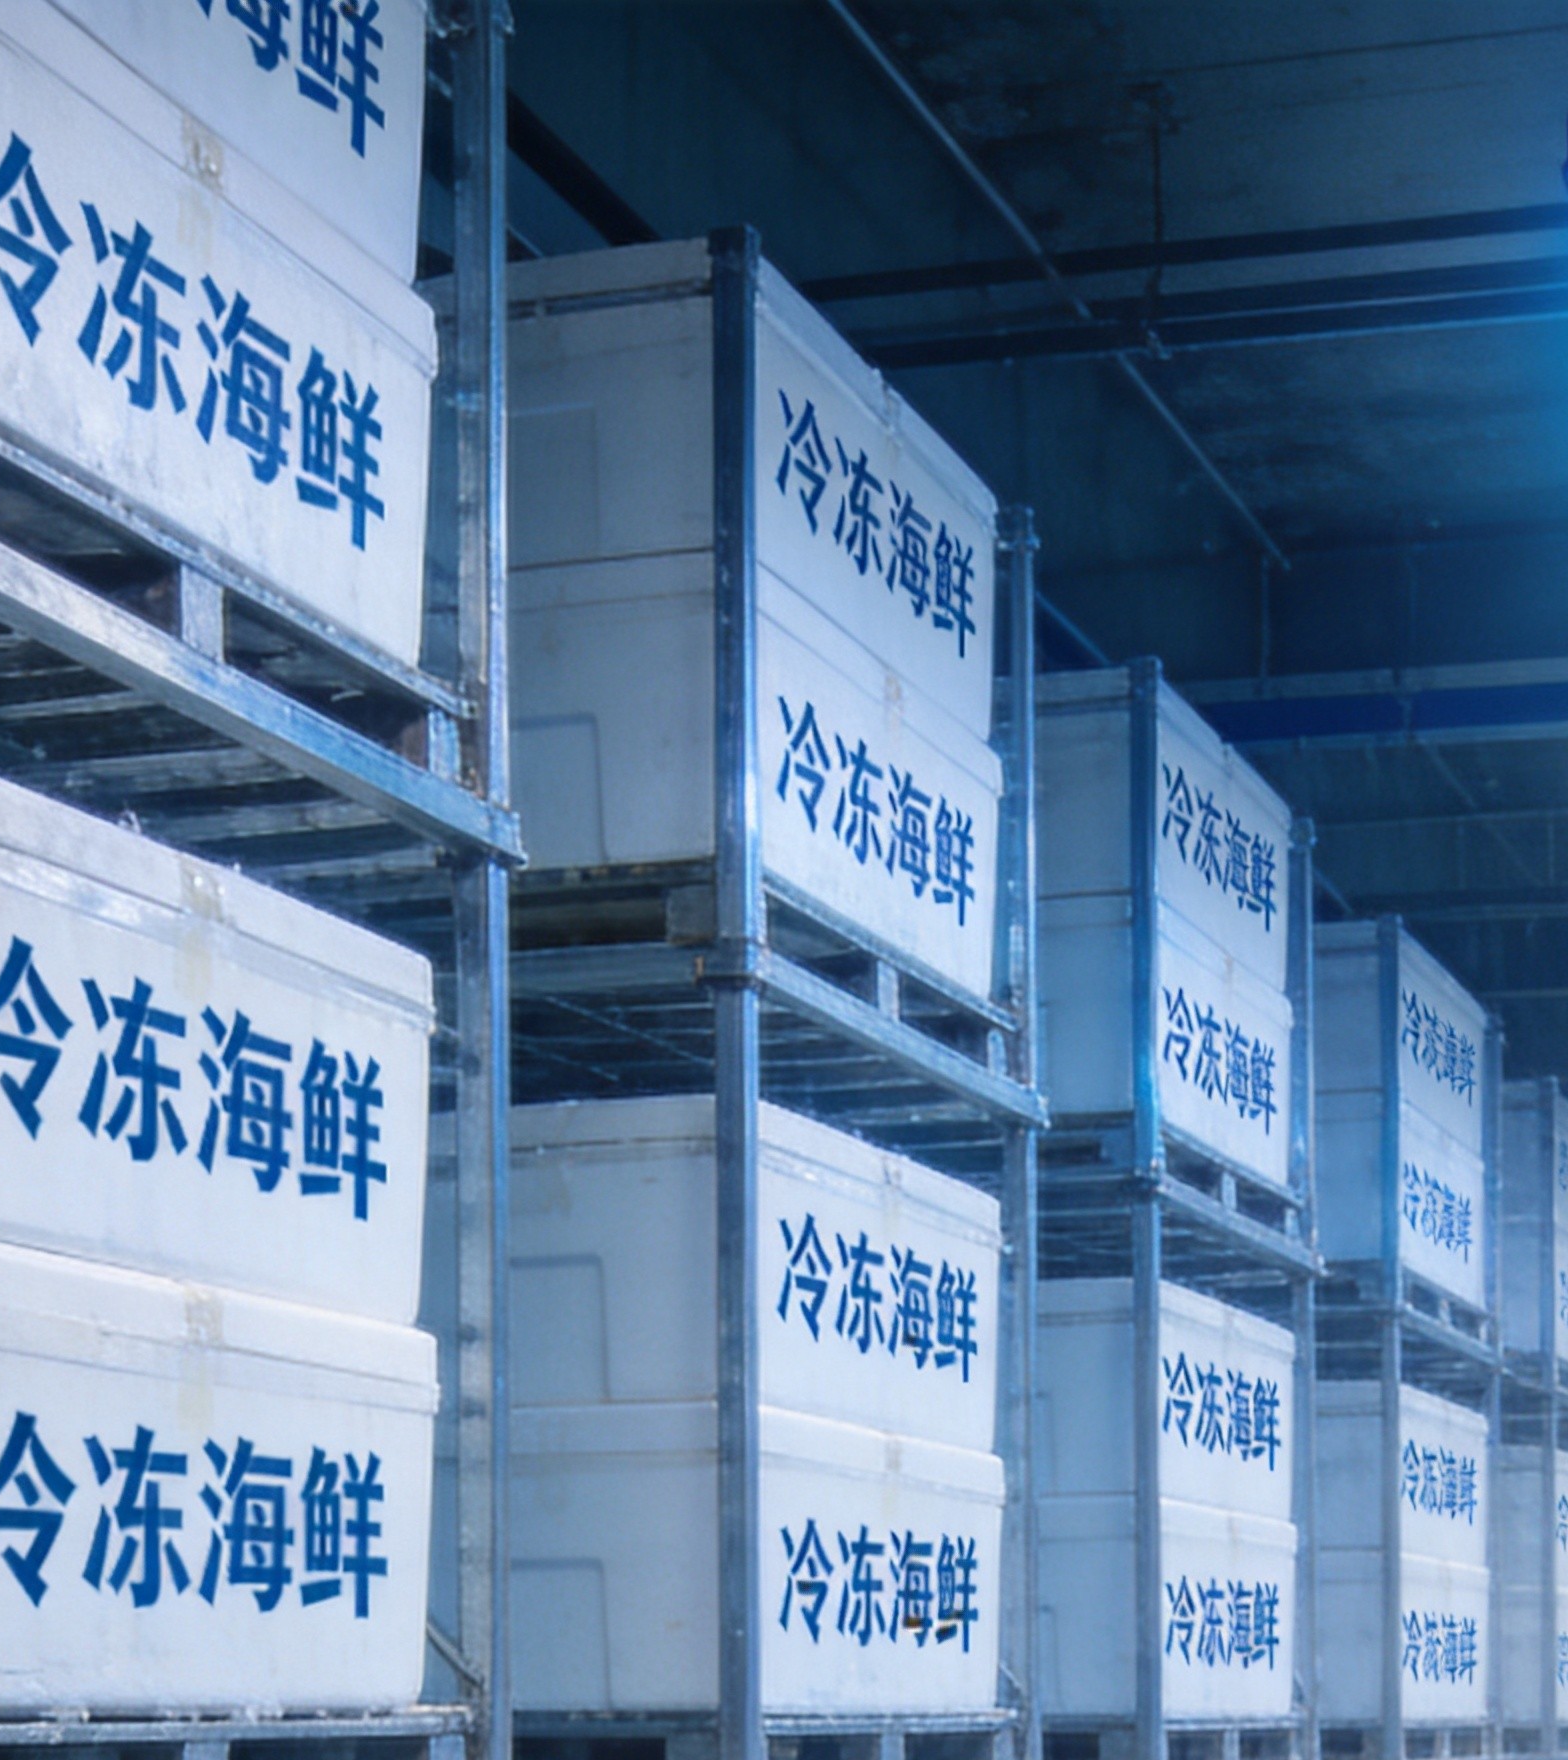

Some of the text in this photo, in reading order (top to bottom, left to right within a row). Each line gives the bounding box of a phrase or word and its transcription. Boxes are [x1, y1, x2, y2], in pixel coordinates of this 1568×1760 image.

[776, 389, 976, 659] 冷冻海鲜
[776, 695, 975, 926] 冷冻海鲜
[1162, 987, 1277, 1136] 冷冻海鲜
[777, 1213, 977, 1383] 冷冻海鲜
[1162, 1352, 1281, 1471] 冷冻海鲜
[779, 1519, 979, 1653] 冷冻海鲜
